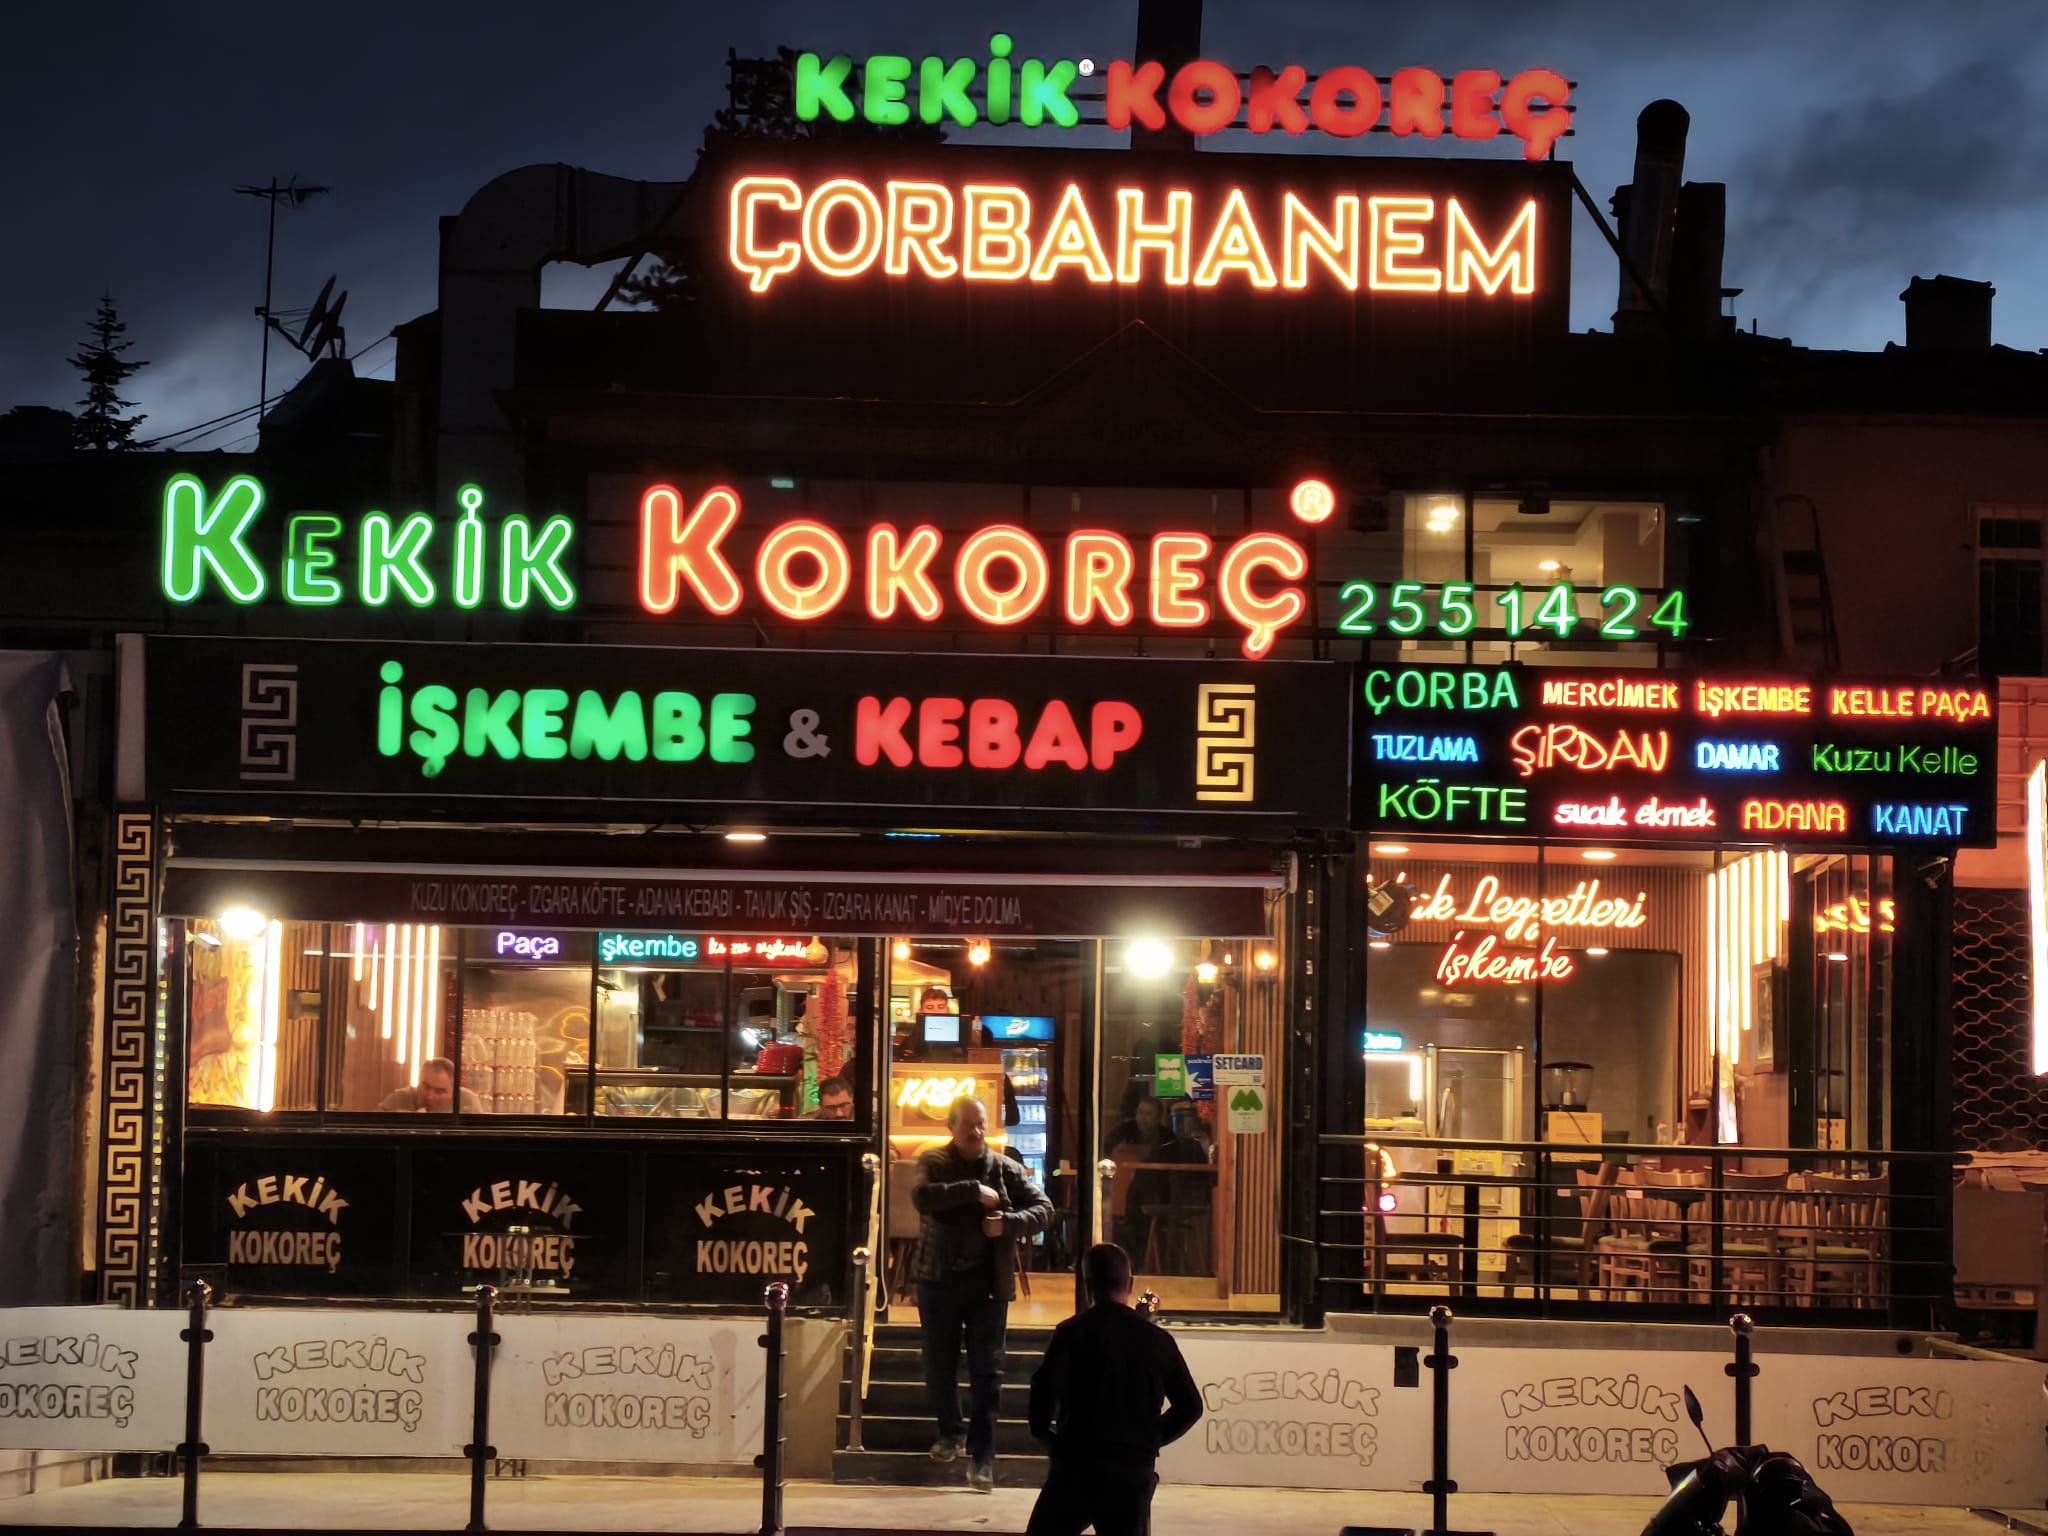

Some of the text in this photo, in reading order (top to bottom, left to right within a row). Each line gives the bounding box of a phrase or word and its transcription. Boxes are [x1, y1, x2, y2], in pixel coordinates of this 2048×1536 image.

[796, 33, 1078, 128] KEKİK
[1106, 60, 1571, 161] KOKOREÇ
[729, 176, 1536, 294] ÇORBAHANEM
[162, 474, 576, 609] KEKİK
[640, 484, 1307, 658] KOKOREÇ
[1338, 581, 1690, 639] 255 14 24
[1365, 670, 1519, 716] ÇORBA
[1542, 679, 1679, 710] MERCİMEK
[1697, 681, 1811, 716] İŞKEMBE
[1831, 688, 1990, 721] KELLE PAÇA
[378, 660, 1142, 778] İŞKEMBE & KEBAP
[1372, 735, 1478, 763] TUZLAMA
[1697, 743, 1780, 772] DAMAR
[1812, 743, 1978, 775] Kuzu Kelle
[1379, 779, 1528, 822] KÖFTE
[1635, 799, 1716, 829] ekmek
[1743, 802, 1846, 833] ADANA
[1874, 805, 1969, 836] KANAT
[411, 881, 447, 912] KUZU
[451, 882, 519, 920] KOKOREÇ
[580, 880, 626, 916] KÖFTE
[637, 887, 682, 917] ADANA
[744, 889, 788, 920] TAVUK
[873, 893, 919, 923] KANAT
[973, 896, 1022, 926] DOLMA
[497, 931, 560, 960] Paça
[1215, 1056, 1263, 1071] SETCARD
[228, 1175, 350, 1225] KEKİK
[461, 1180, 583, 1231] KEKİK
[694, 1184, 816, 1235] KEKİK
[229, 1231, 342, 1274] KOKOREÇ
[696, 1240, 809, 1284] KOKOREÇ
[0, 1333, 139, 1379] EKİK
[254, 1336, 426, 1384] KEKİK
[542, 1342, 714, 1391] KEKİK
[0, 1383, 135, 1429] OKOREÇ
[256, 1386, 423, 1433] KOKOREÇ
[545, 1391, 711, 1440] KOKOREÇ
[1202, 1368, 1381, 1417] KEKİK
[1500, 1373, 1681, 1423] KEKİK
[1206, 1418, 1378, 1467] KOKOREÇ
[1816, 1433, 1950, 1474] KOKOR
